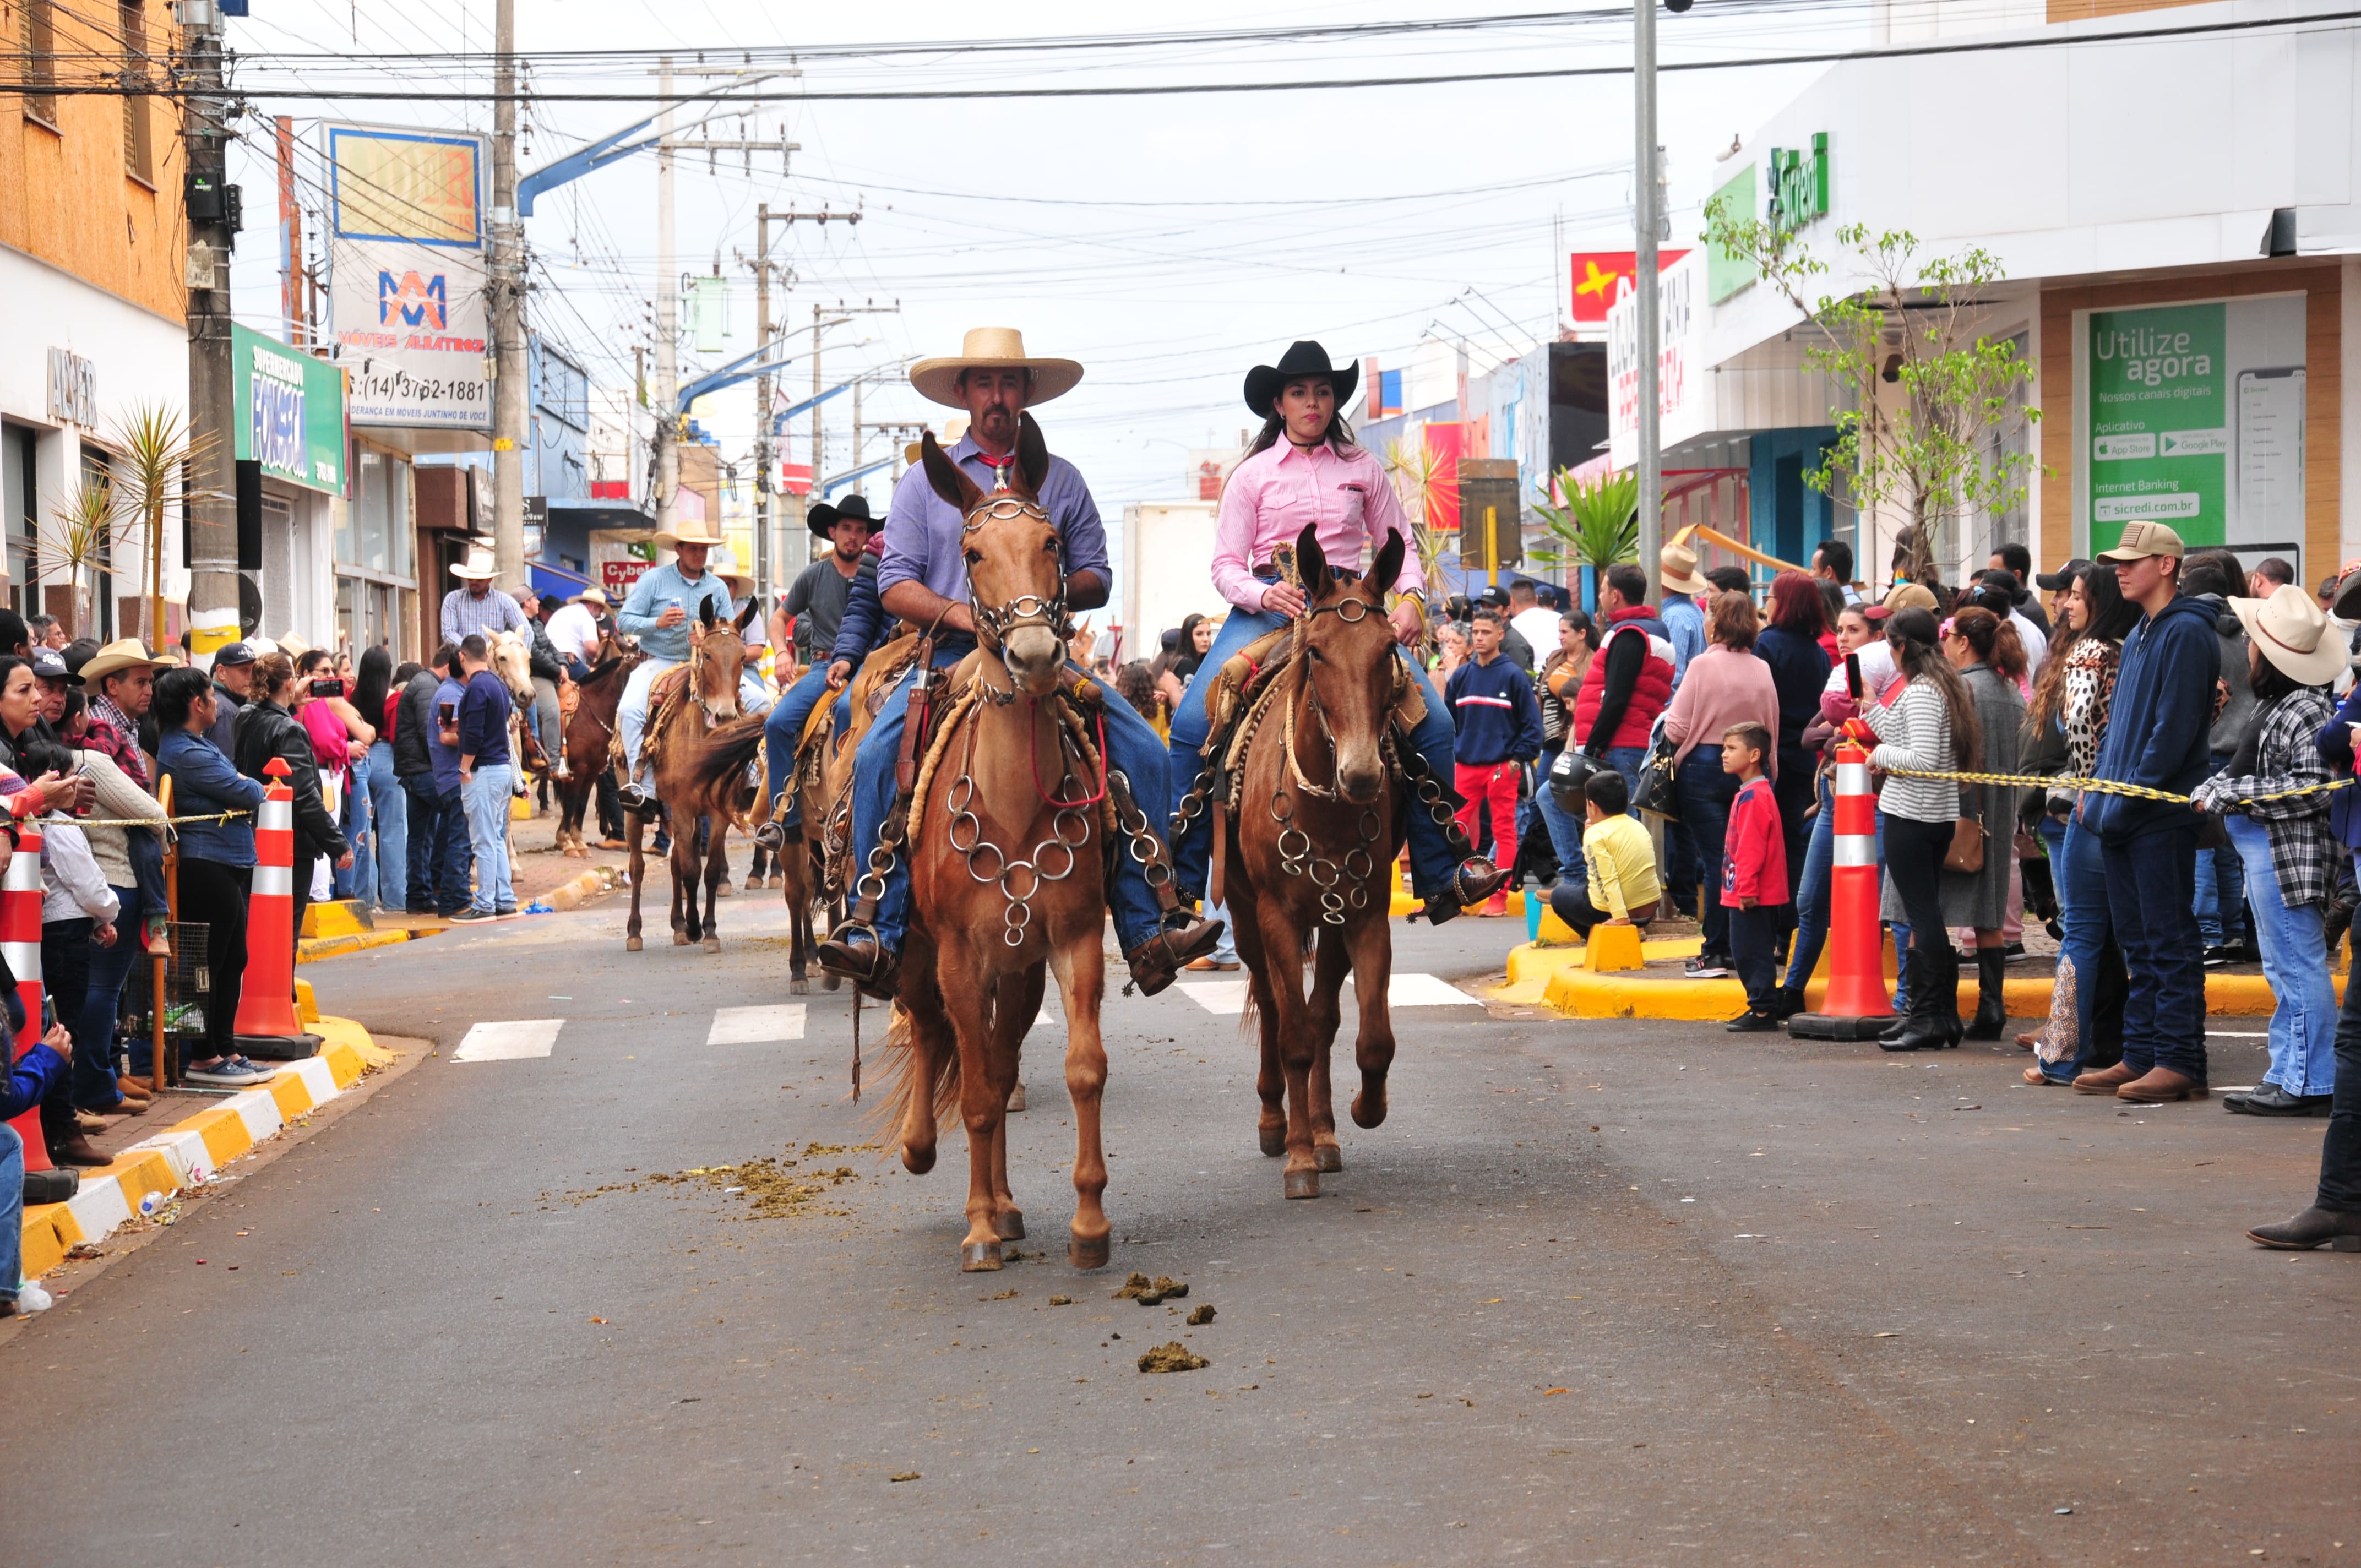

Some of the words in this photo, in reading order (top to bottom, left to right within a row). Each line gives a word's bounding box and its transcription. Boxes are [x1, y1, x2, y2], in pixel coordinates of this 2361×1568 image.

[405, 335, 485, 353] ALBATROZ
[2097, 328, 2190, 360] Utilize
[253, 345, 303, 386] SUPERMERCADO
[2128, 354, 2211, 386] agora
[401, 378, 485, 401] 3762-1881
[2099, 392, 2136, 403] Nossos
[2139, 389, 2172, 400] canais
[2174, 386, 2211, 400] digitais
[351, 405, 384, 418] DERANÇA
[385, 407, 395, 417] EM
[396, 406, 421, 417] MÓVEIS
[423, 409, 456, 420] JUNTINHO
[459, 411, 467, 420] DE
[470, 410, 487, 421] VOCÊ
[251, 373, 307, 478] FONSECA
[2096, 422, 2145, 434] Aplicativo
[2112, 445, 2128, 455] App
[2130, 444, 2151, 453] Store
[2181, 440, 2209, 451] Google
[2211, 439, 2227, 449] Play
[2096, 482, 2135, 493] Internet
[2139, 480, 2179, 491] Banking
[2114, 500, 2193, 514] sicredi.com.br
[607, 564, 656, 581] Cybel
